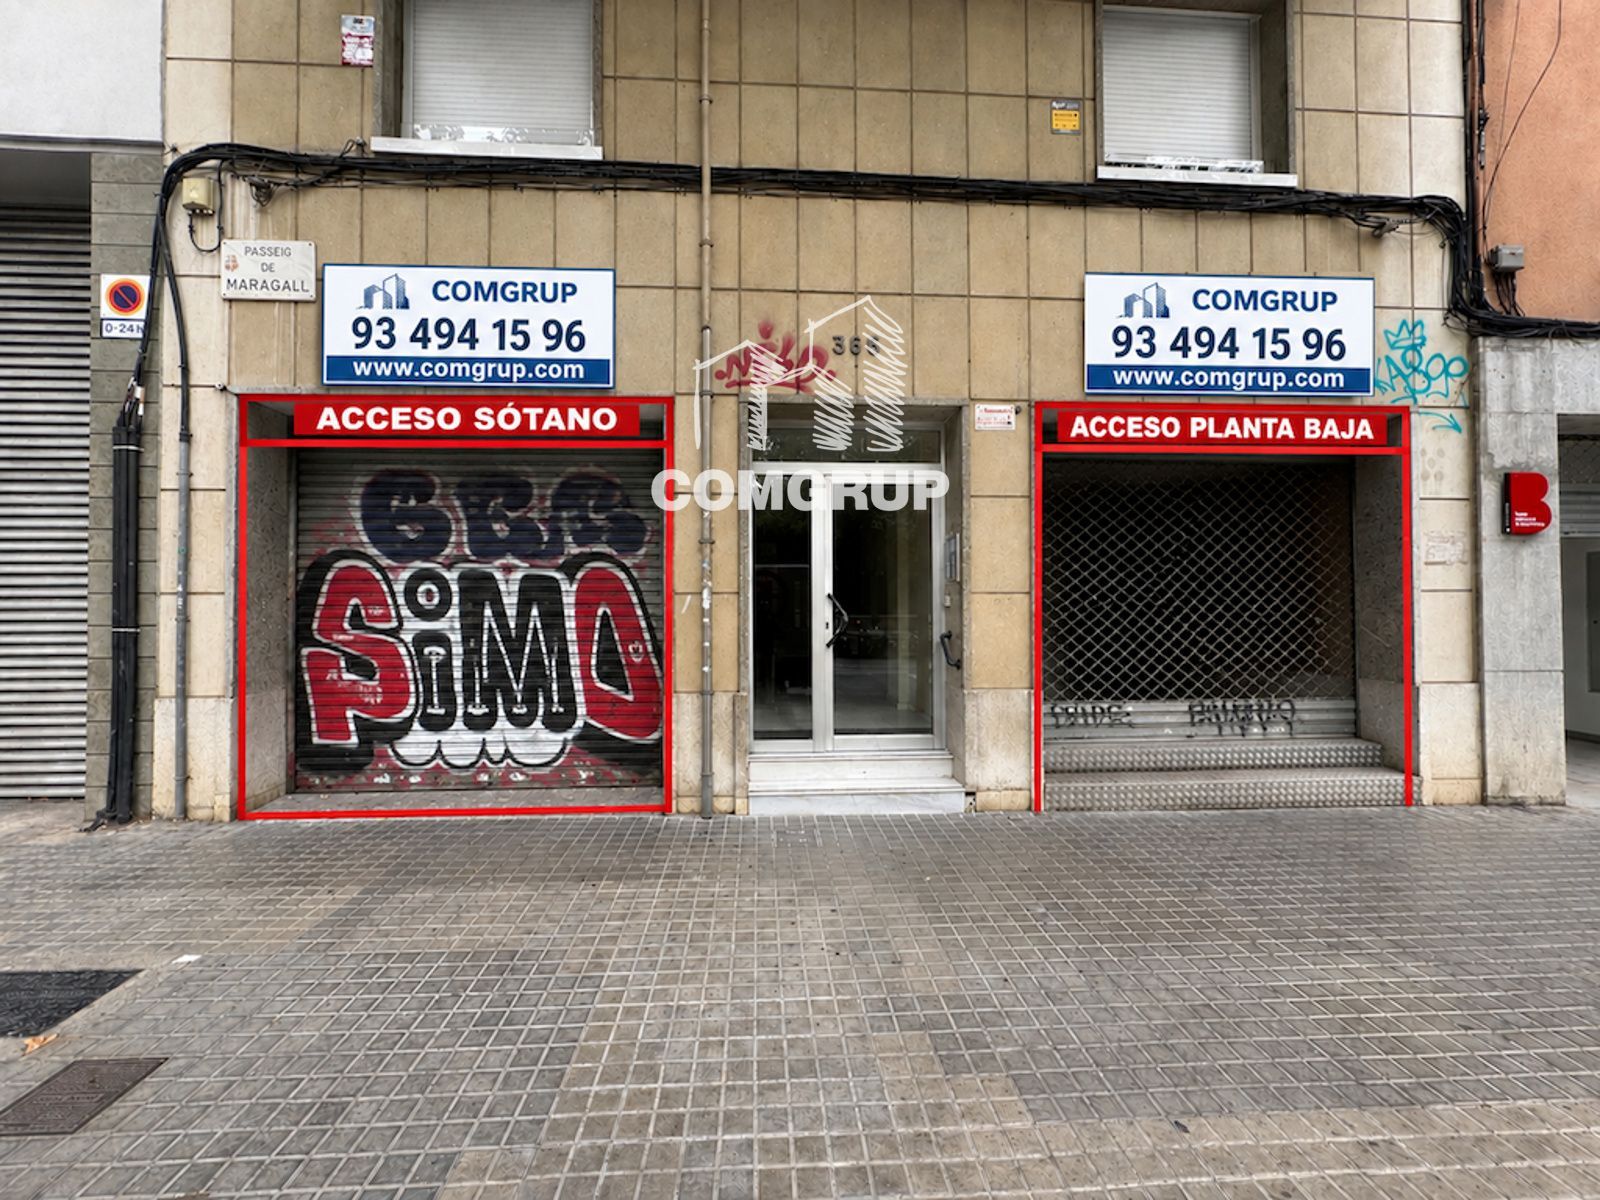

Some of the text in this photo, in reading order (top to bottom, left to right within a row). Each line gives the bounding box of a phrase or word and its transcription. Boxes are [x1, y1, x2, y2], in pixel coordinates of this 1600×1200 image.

[244, 246, 292, 257] PASSEIG
[260, 262, 276, 273] DE
[226, 278, 310, 293] MARAGALL
[432, 280, 578, 303] COMGRUP
[1192, 289, 1338, 312] COMGRUP
[351, 316, 586, 353] 93 494 15 96
[1111, 325, 1346, 362] 93 494 15 96
[352, 361, 585, 382] www.comgrup.com
[1112, 369, 1345, 391] www.comgrup.com
[316, 402, 618, 431] ACCESO SÓTANO
[1070, 415, 1374, 440] ACCESO PLANTA BAJA
